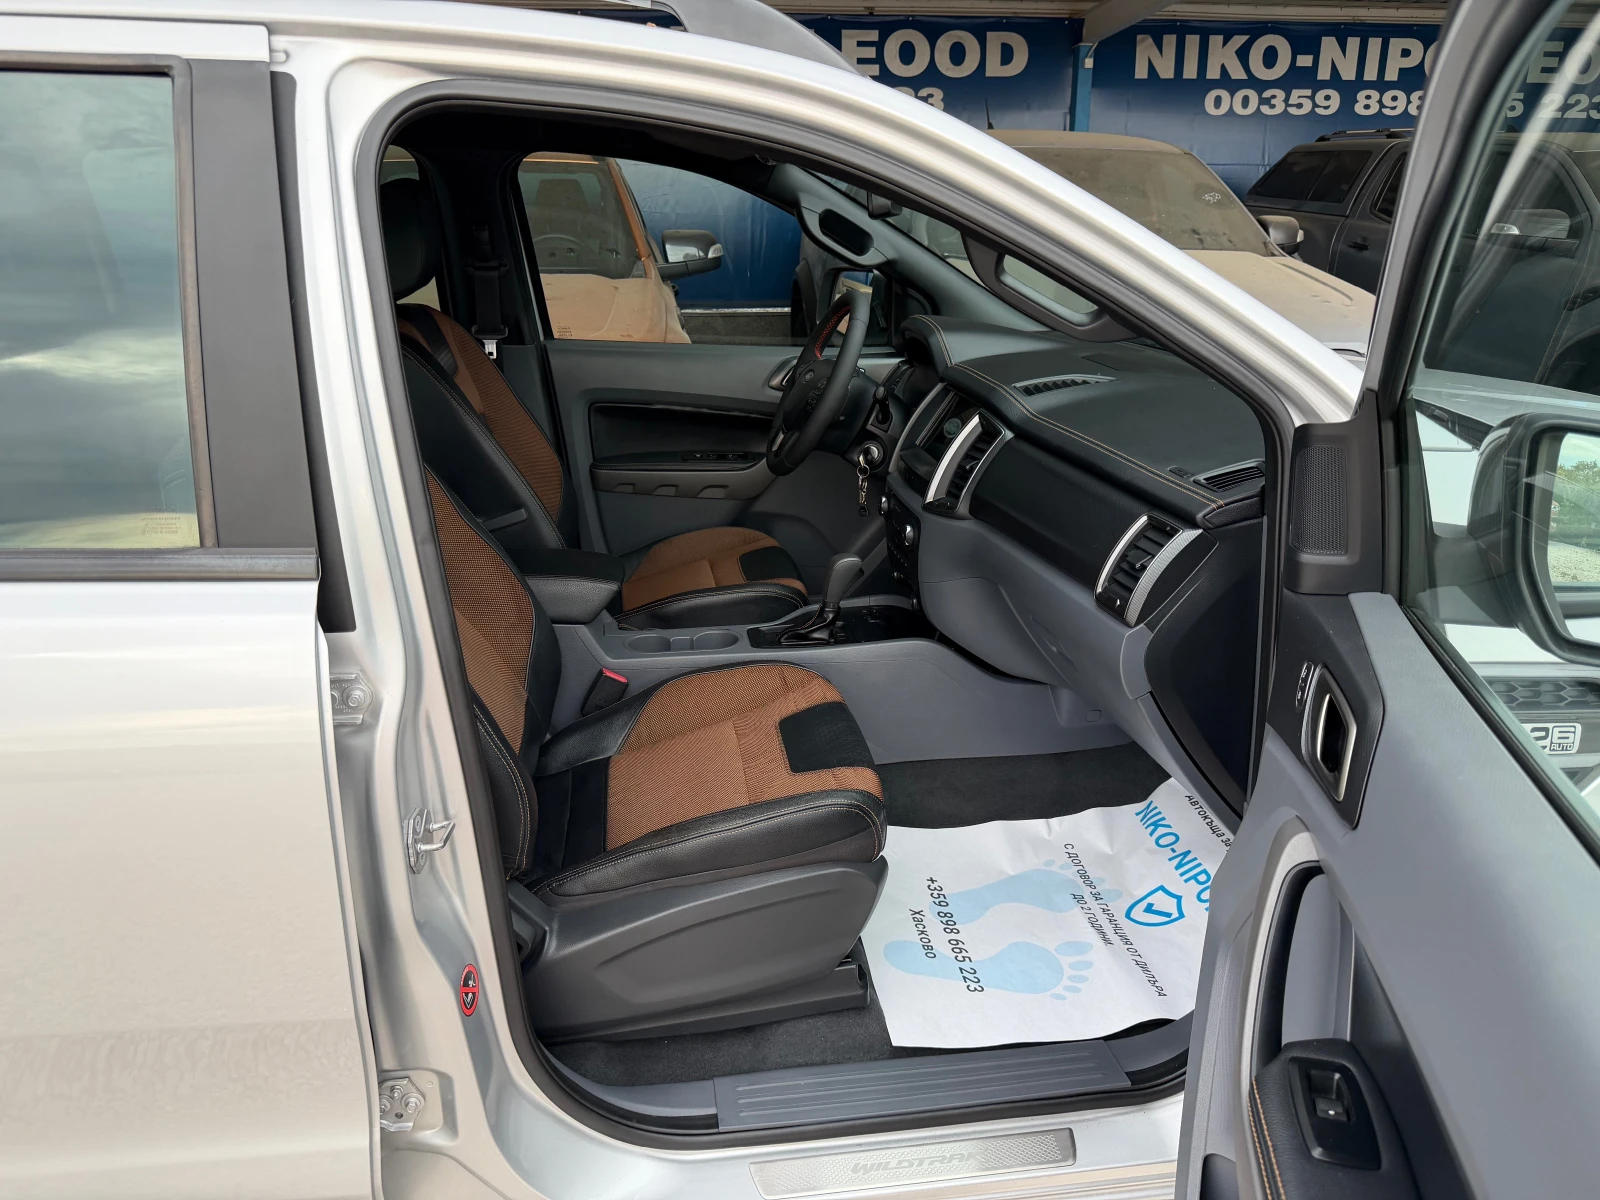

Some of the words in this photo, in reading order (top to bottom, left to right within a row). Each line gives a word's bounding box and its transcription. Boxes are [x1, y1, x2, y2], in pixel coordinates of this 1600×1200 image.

[841, 29, 1029, 78] EOOD
[1134, 33, 1439, 81] NIKO-NIP
[1204, 89, 1340, 116] 00359
[1550, 743, 1574, 751] AUTO
[1134, 800, 1210, 912] NIKO-NIPO
[1065, 851, 1096, 890] ДОГОВОР
[926, 876, 949, 908] +359
[1070, 893, 1087, 907] ДО
[1090, 890, 1103, 902] ЗА
[909, 908, 937, 959] Хасково
[937, 910, 960, 935] 898
[1096, 902, 1133, 946] ГАРАНЦИЯ
[948, 938, 972, 963] 665
[1126, 947, 1142, 959] ОТ
[958, 966, 985, 993] 223
[1132, 957, 1167, 997] ДИЛЪРА
[850, 1151, 979, 1175] WILDTRAK
